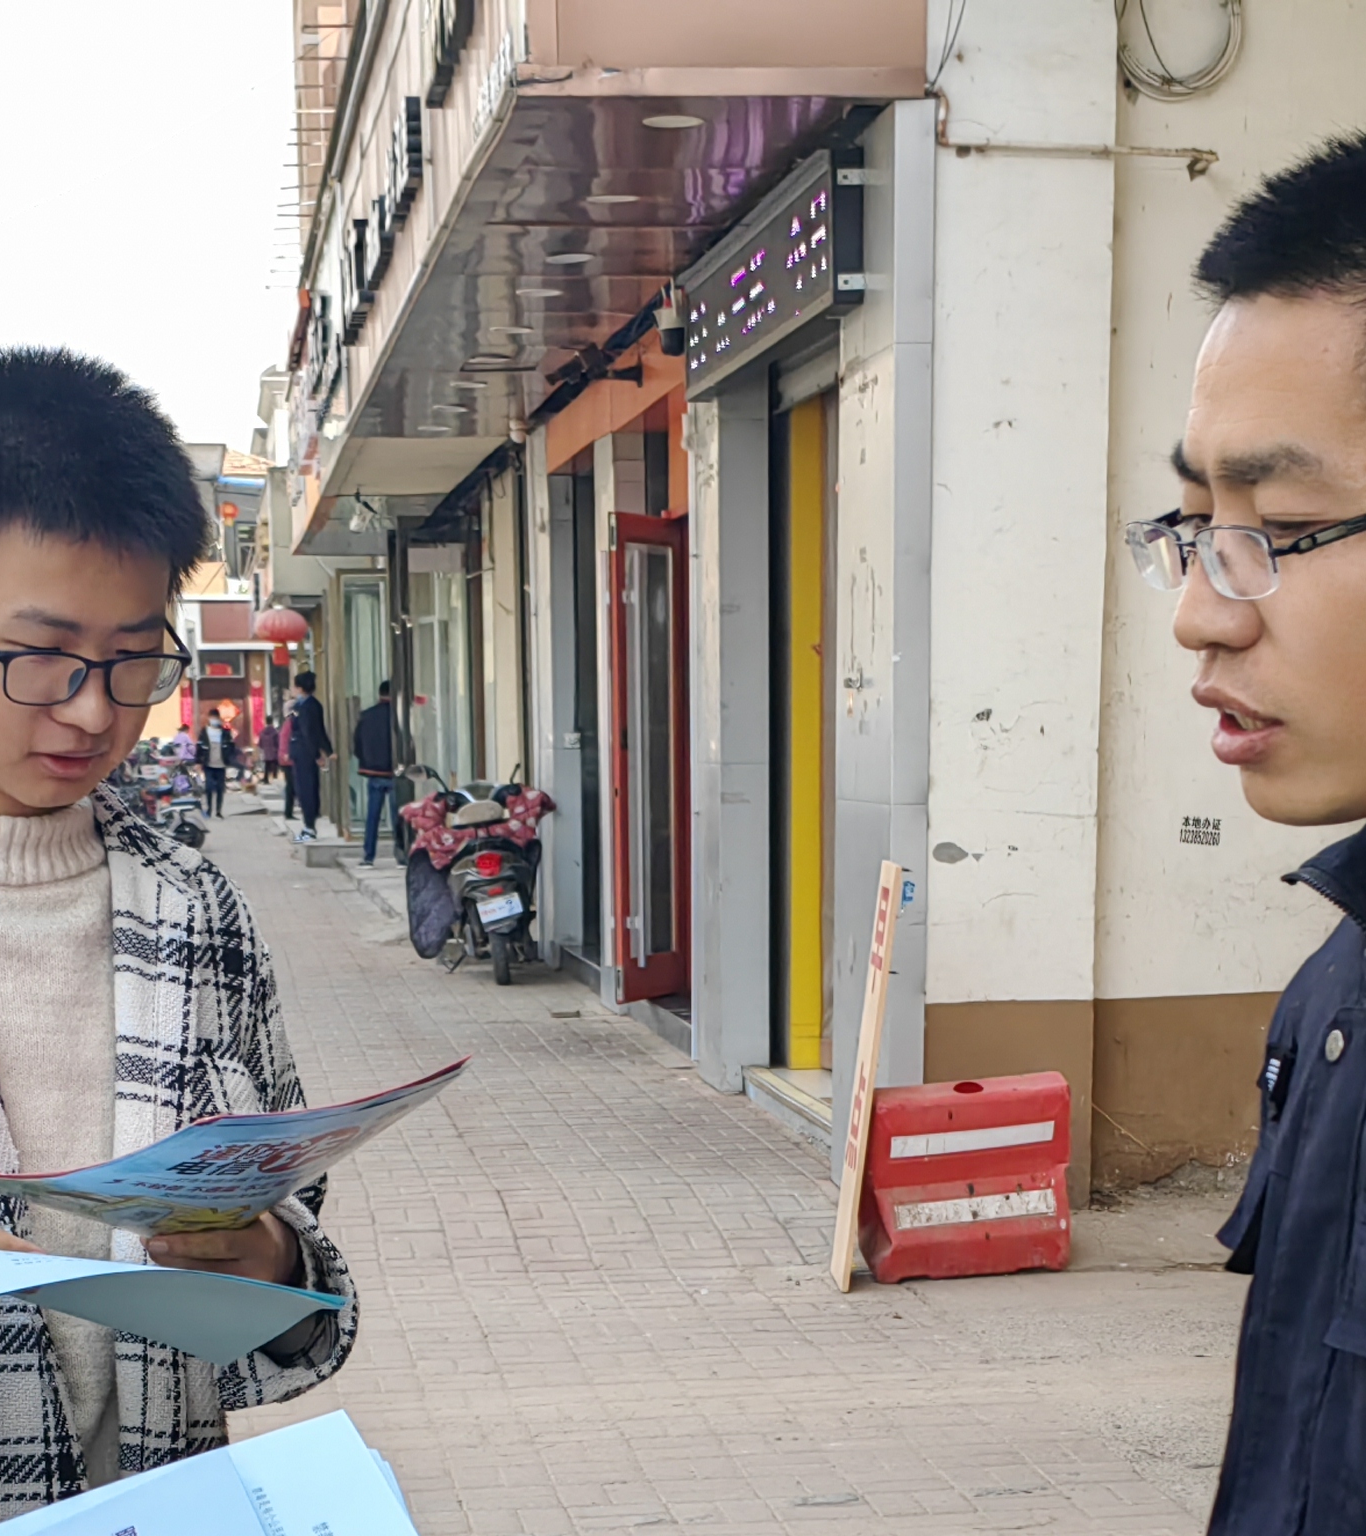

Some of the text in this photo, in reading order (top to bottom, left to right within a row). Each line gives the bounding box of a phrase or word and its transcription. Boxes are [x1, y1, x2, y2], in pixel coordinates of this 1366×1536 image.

[1181, 815, 1222, 831] 本地办证
[166, 1159, 264, 1177] 电信
